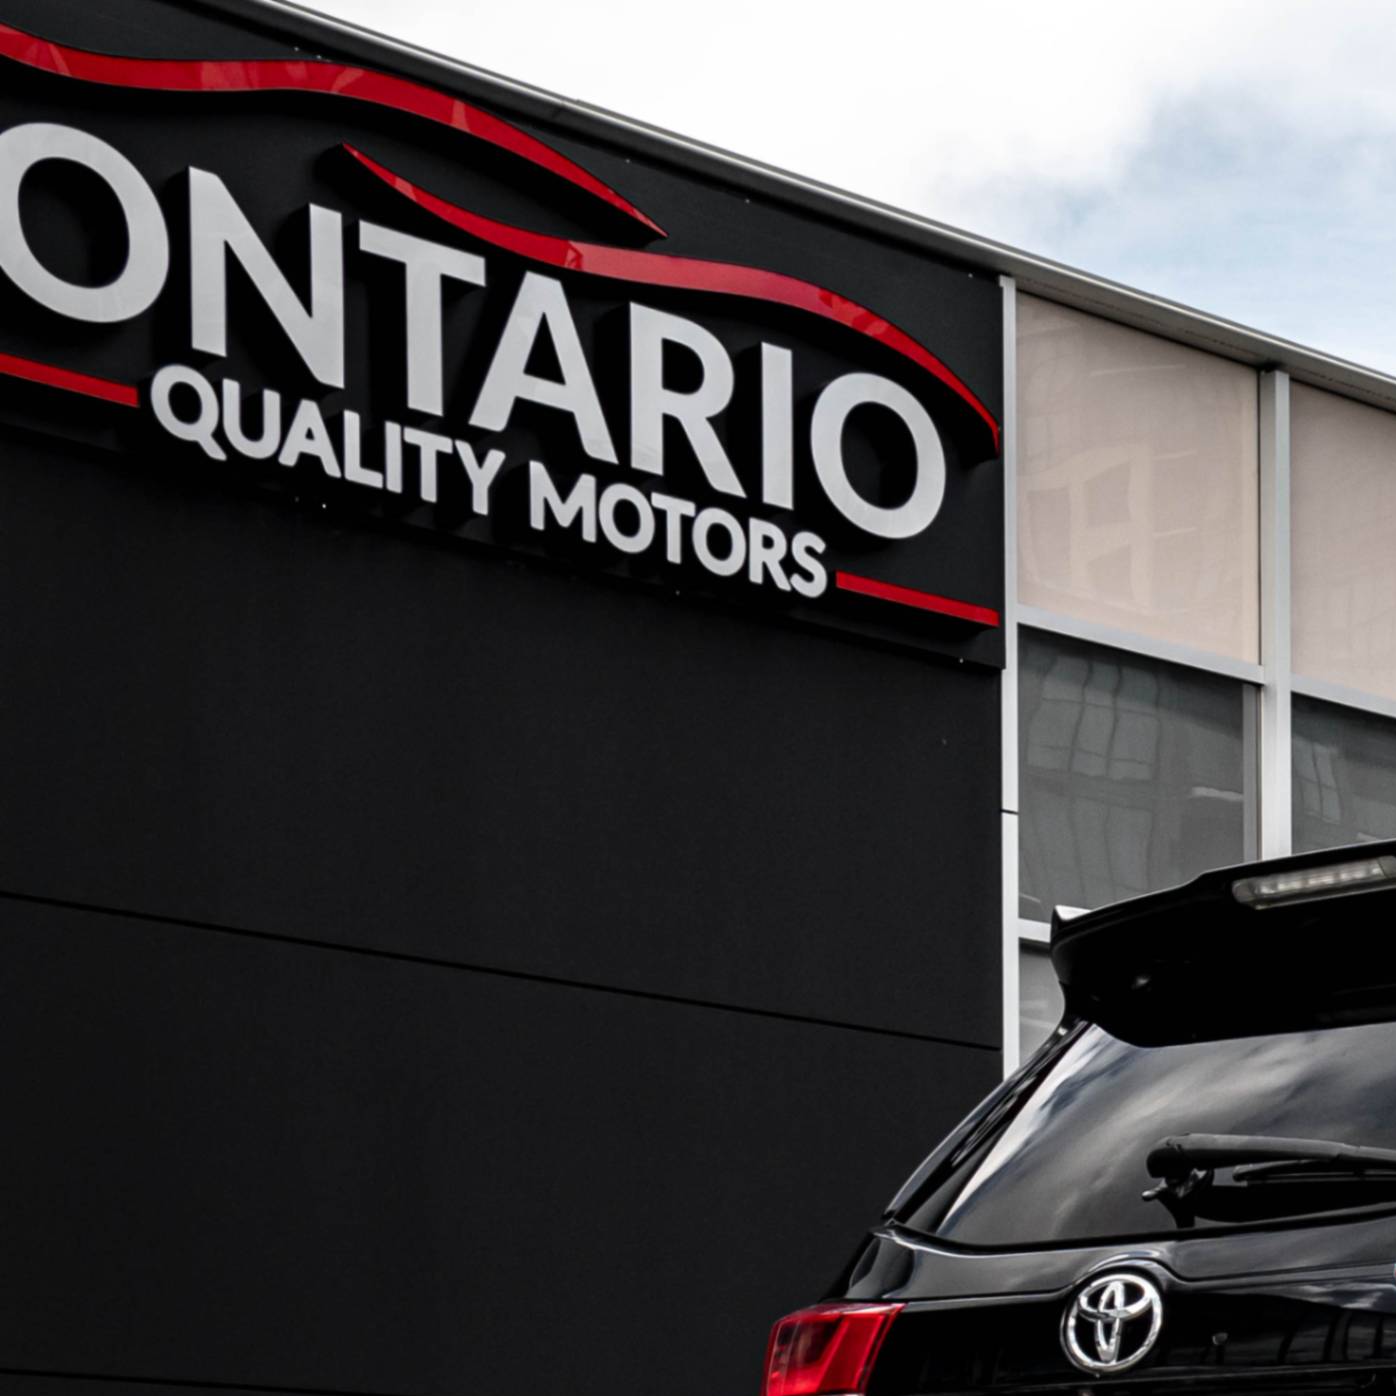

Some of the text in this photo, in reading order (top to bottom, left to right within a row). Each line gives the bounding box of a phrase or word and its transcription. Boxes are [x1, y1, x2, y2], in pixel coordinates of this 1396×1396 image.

[0, 122, 947, 540] ONTARIO
[150, 363, 828, 599] QUALITY MOTORS
